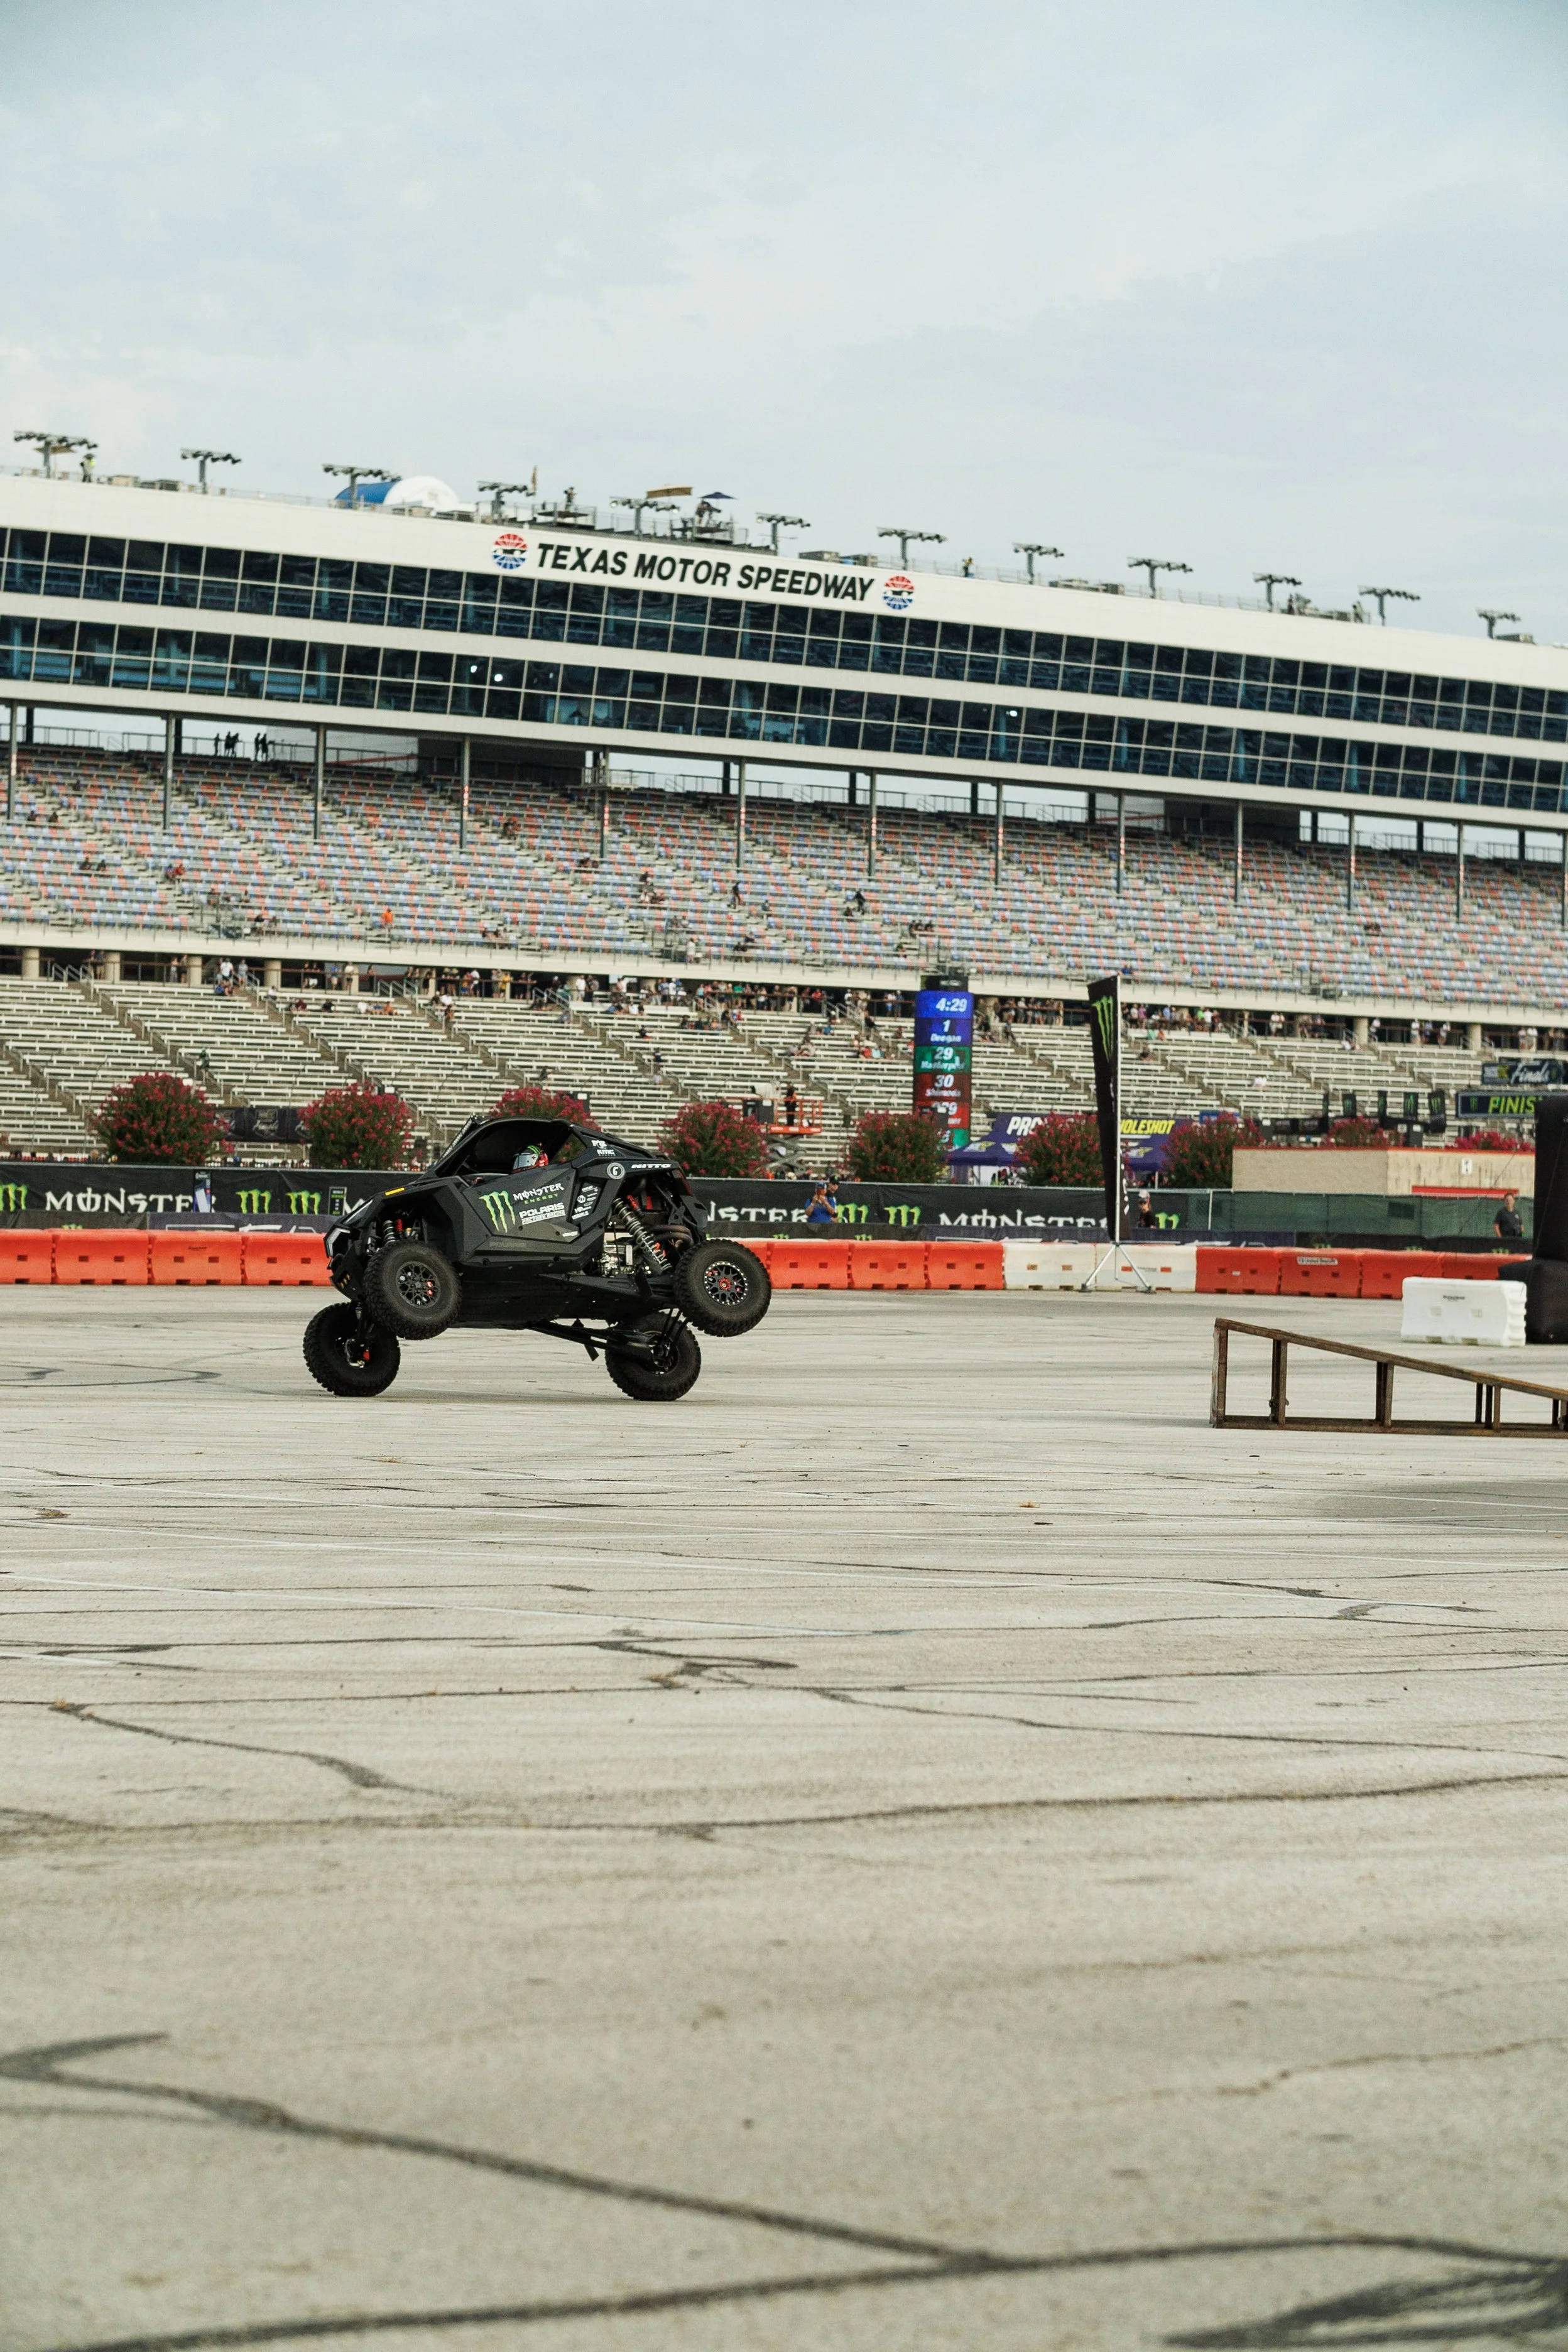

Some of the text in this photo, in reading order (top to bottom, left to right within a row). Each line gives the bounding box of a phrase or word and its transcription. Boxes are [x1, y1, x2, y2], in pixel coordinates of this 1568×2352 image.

[538, 543, 875, 601] TEXAS MOTOR SPEEDWAY
[935, 998, 967, 1012] 4:29
[943, 1020, 950, 1032] 1
[934, 1047, 954, 1060] 29
[934, 1074, 954, 1088] 30
[1488, 1096, 1543, 1114] FINIS
[513, 1183, 565, 1200] MONSTER
[524, 1193, 559, 1204] ENERGY
[45, 1187, 217, 1214] MONSTE
[519, 1202, 565, 1219] POLARIS
